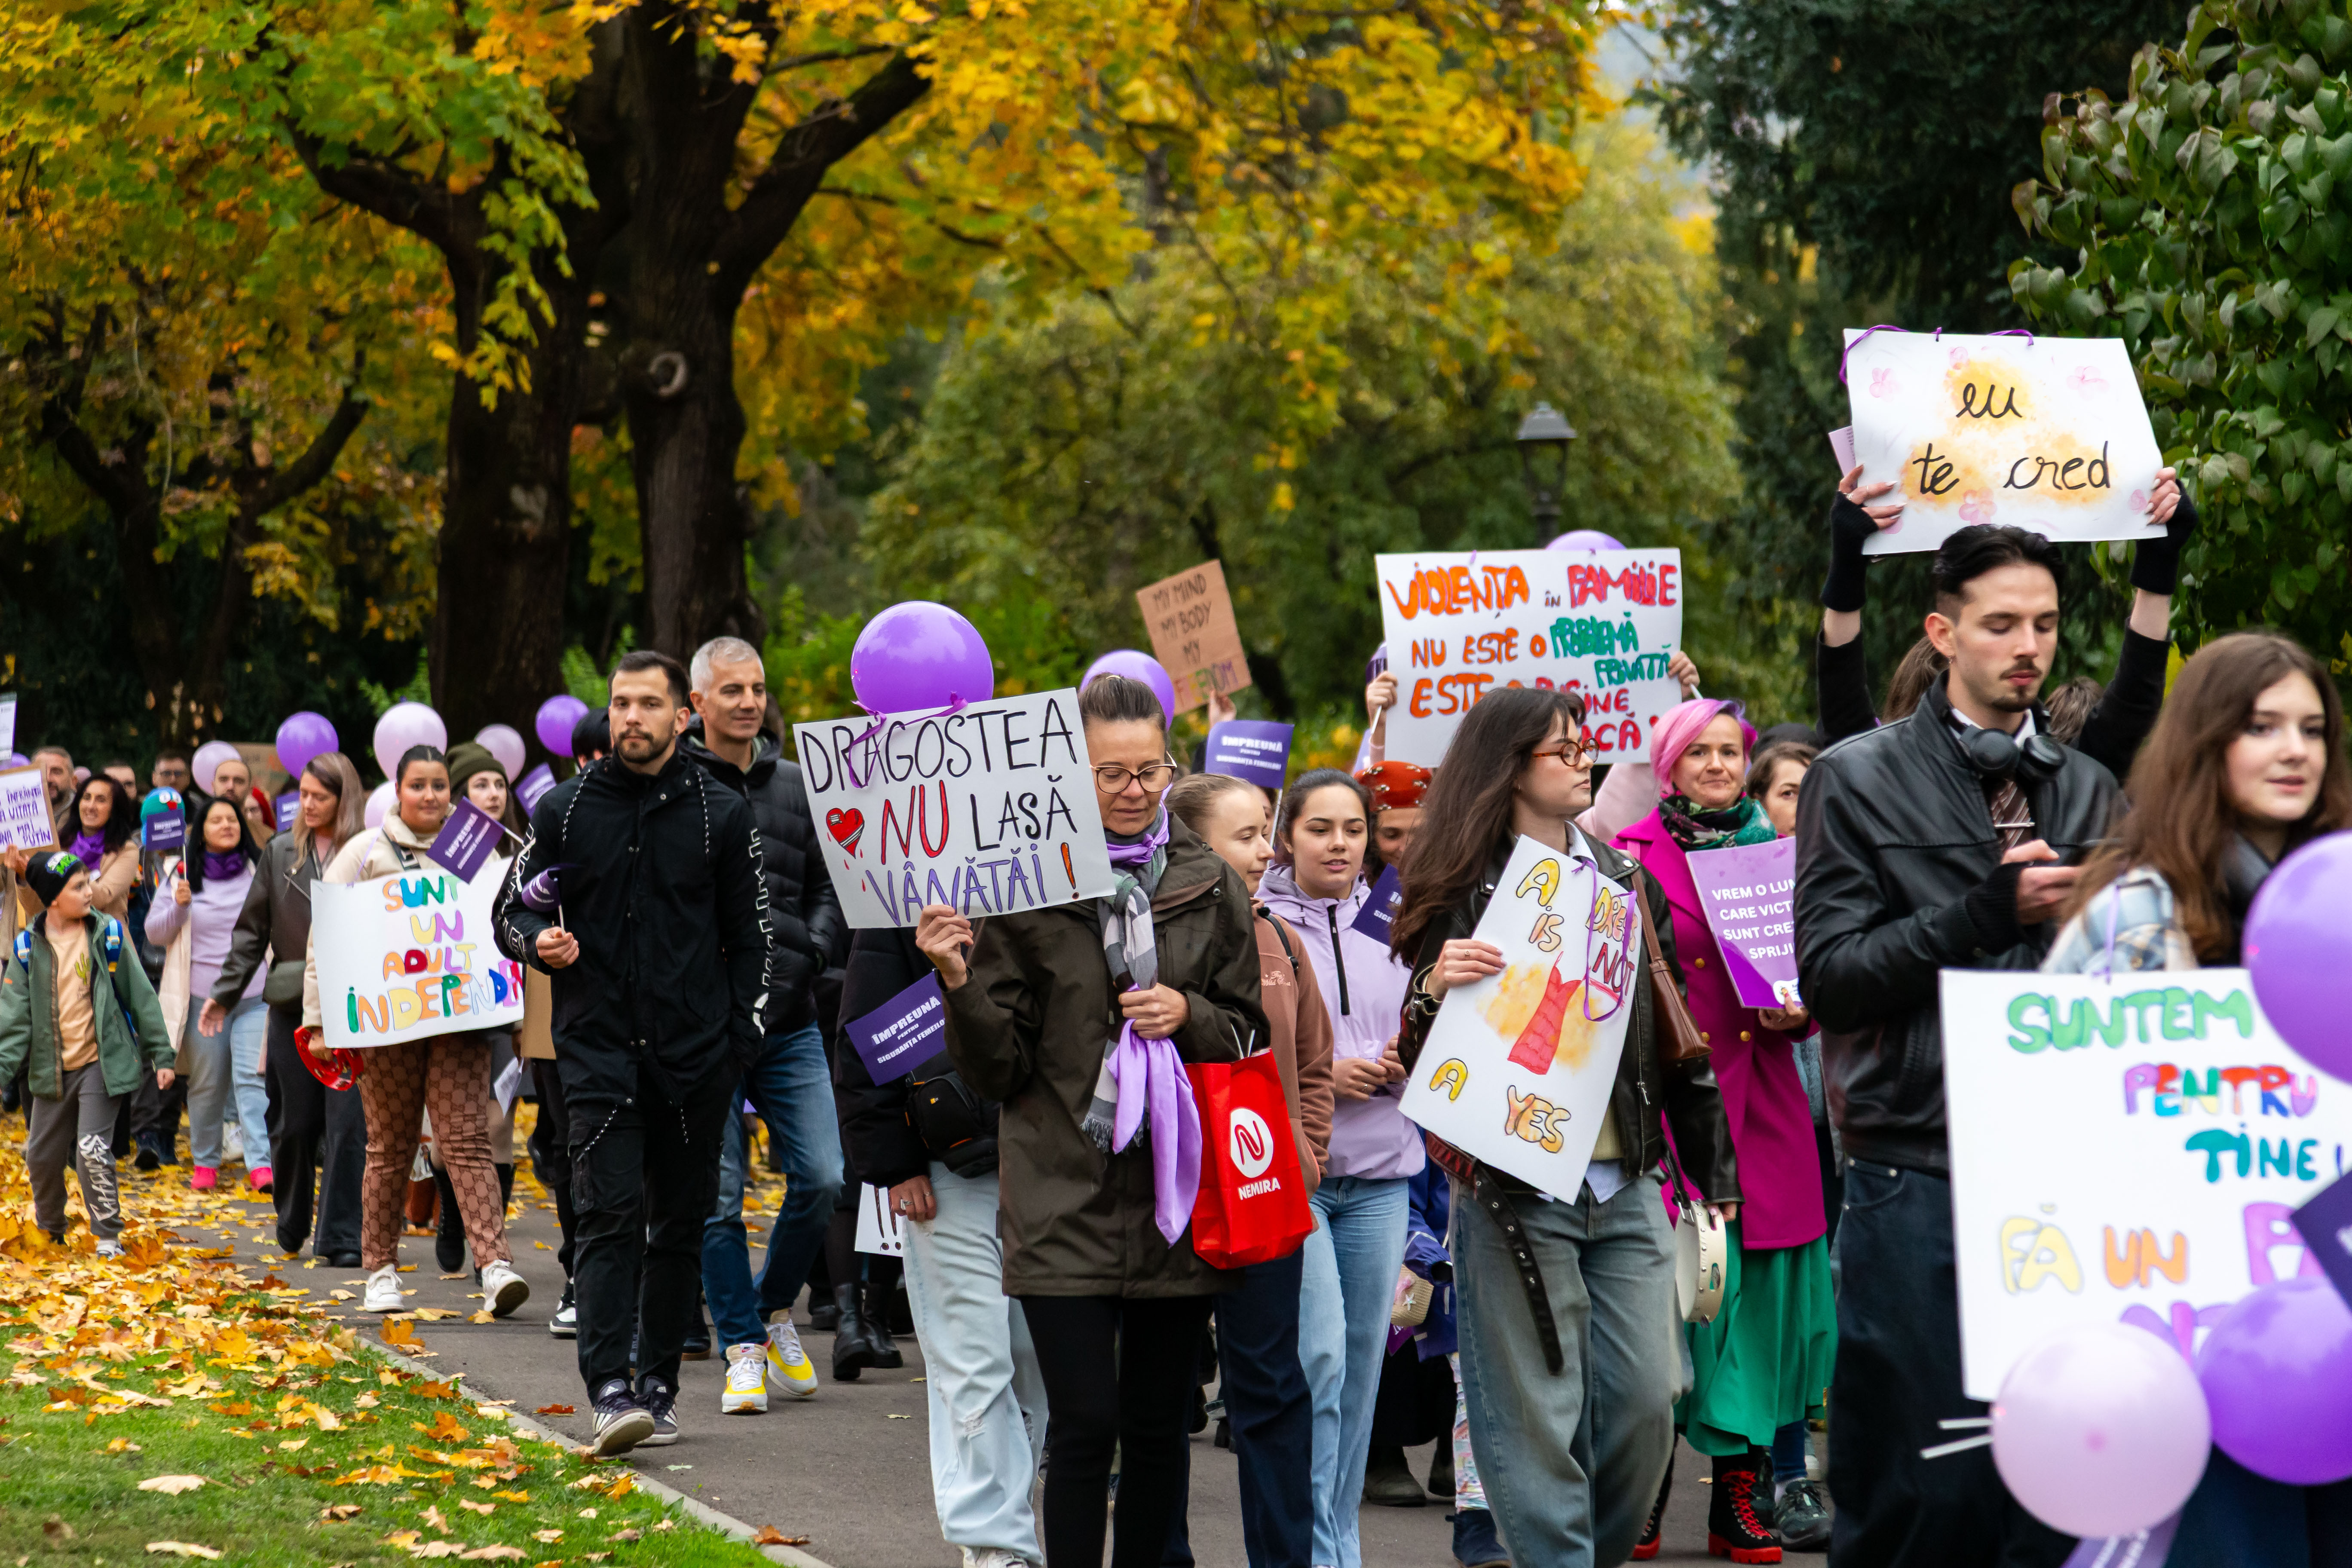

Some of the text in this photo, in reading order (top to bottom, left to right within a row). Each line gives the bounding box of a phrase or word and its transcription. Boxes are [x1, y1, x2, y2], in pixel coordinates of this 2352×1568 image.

[1912, 443, 1960, 495] te
[2003, 441, 2111, 490] cred
[1412, 638, 1446, 668] NU
[1463, 628, 1519, 664] ESTE
[1530, 634, 1547, 658] O
[802, 698, 1077, 793] DRAGOSTEA
[882, 780, 949, 865] NU
[383, 875, 460, 912] SUNT
[1516, 858, 1638, 952] A DRES
[1712, 886, 1752, 901] VREM
[1755, 885, 1767, 896] O
[1720, 900, 1794, 921] CARE VICT
[411, 910, 464, 944] UN
[1723, 921, 1795, 940] SUNT CRE
[383, 944, 477, 982] ADULT
[1592, 942, 1635, 997] NOT
[1749, 943, 1794, 959] SPRIJI
[871, 995, 941, 1045] ÎMPREUNĂ
[916, 1018, 945, 1041] FEMEILO
[2006, 987, 2254, 1054] SUNTEM
[1429, 1057, 1571, 1154] A YES
[2124, 1063, 2317, 1118] PENTRU
[1238, 1177, 1281, 1200] NEMIRA
[1999, 1203, 2083, 1295] FĂ
[2103, 1224, 2188, 1289] UN
